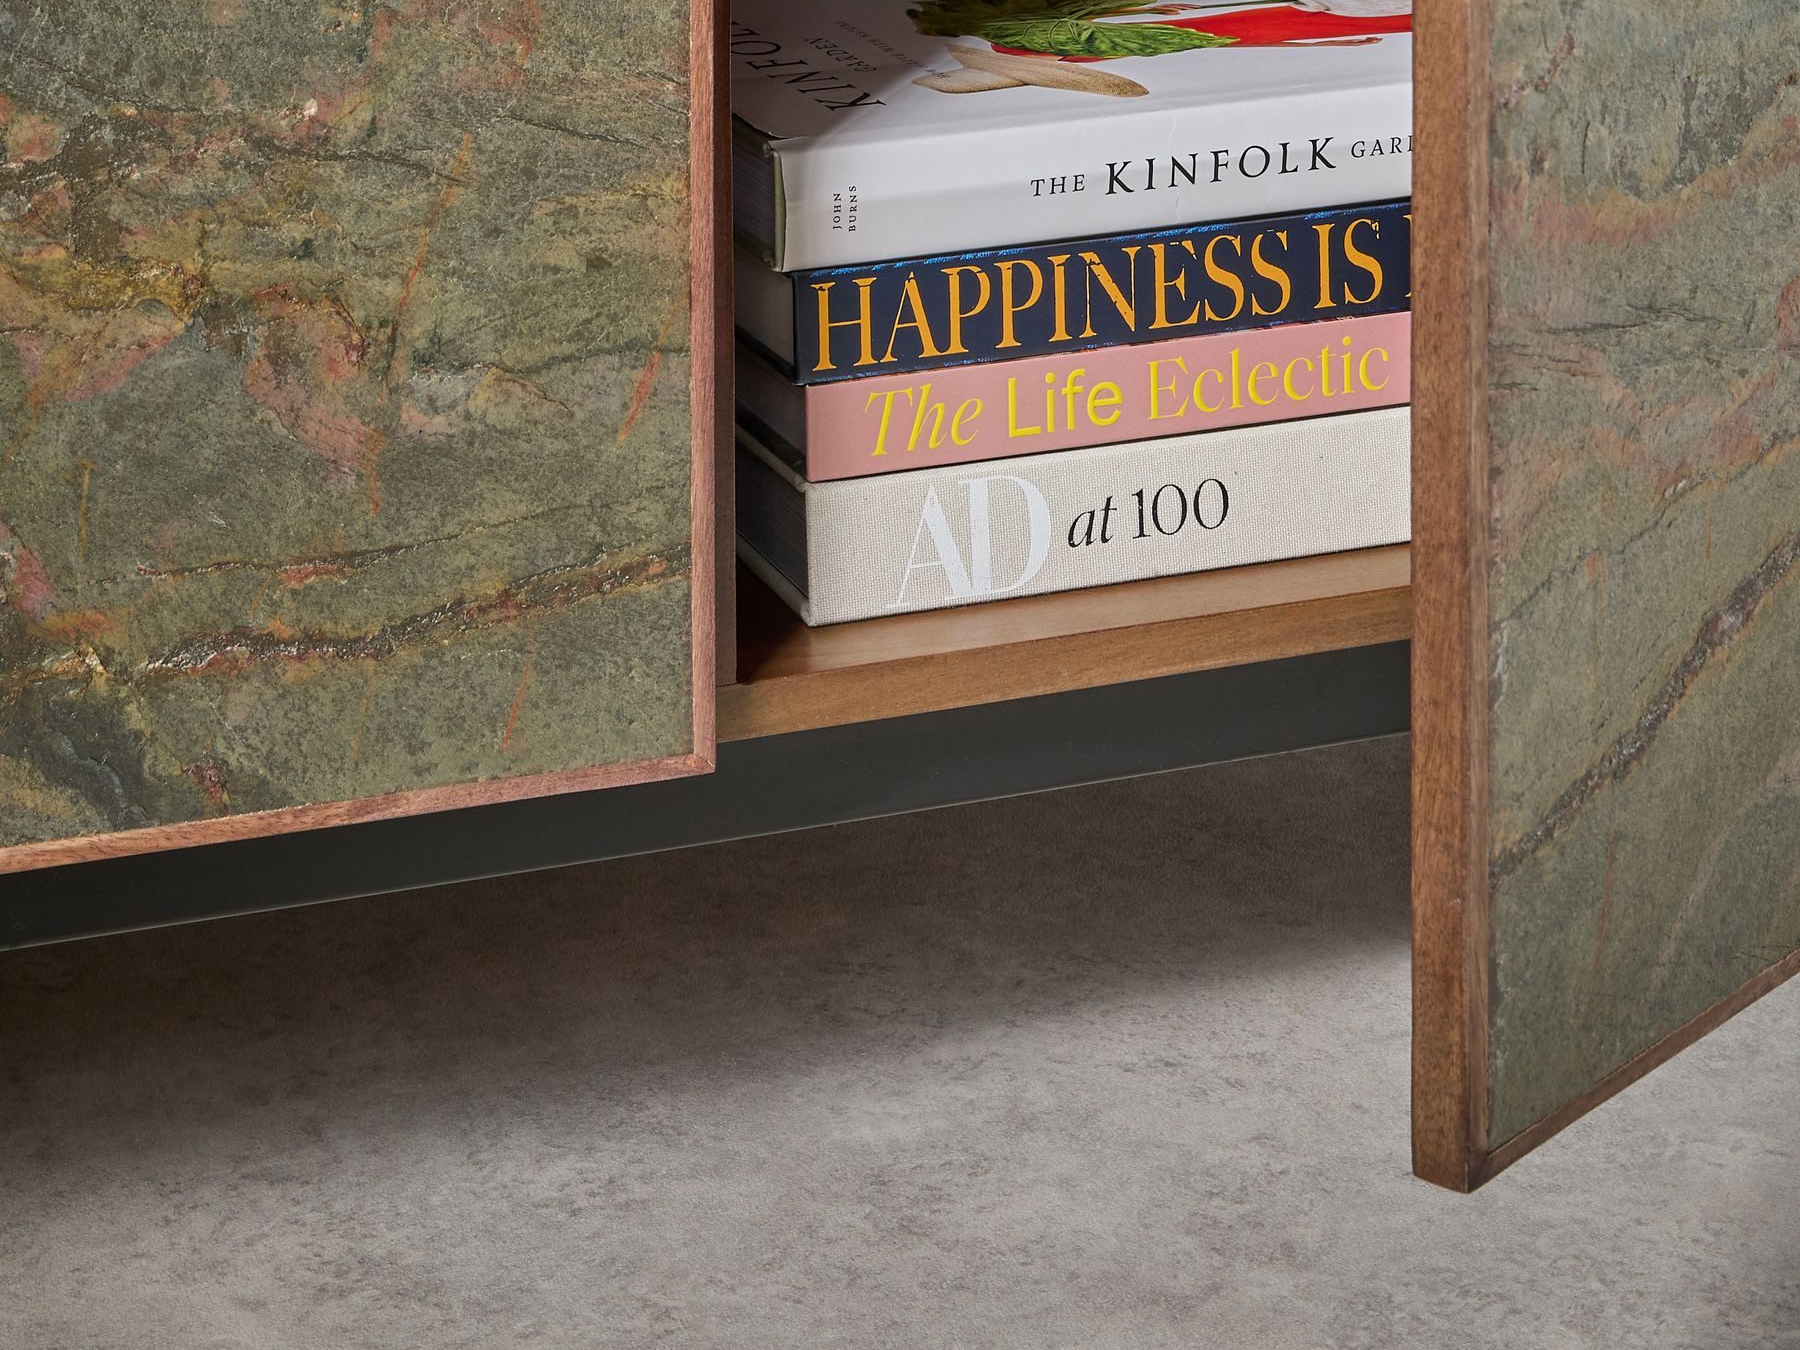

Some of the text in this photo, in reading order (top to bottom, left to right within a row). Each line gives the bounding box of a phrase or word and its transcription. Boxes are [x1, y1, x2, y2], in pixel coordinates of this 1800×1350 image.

[731, 20, 887, 112] KINFOL
[804, 38, 878, 73] GARDEN
[1030, 135, 1412, 197] THE KINFOLK GAR
[832, 193, 842, 230] JOHN
[848, 185, 858, 232] BURNS
[811, 231, 1291, 372] HAPPINESS
[1313, 218, 1384, 310] IS
[863, 336, 1390, 457] The Life Eclectic
[884, 474, 1230, 609] AD at 100
